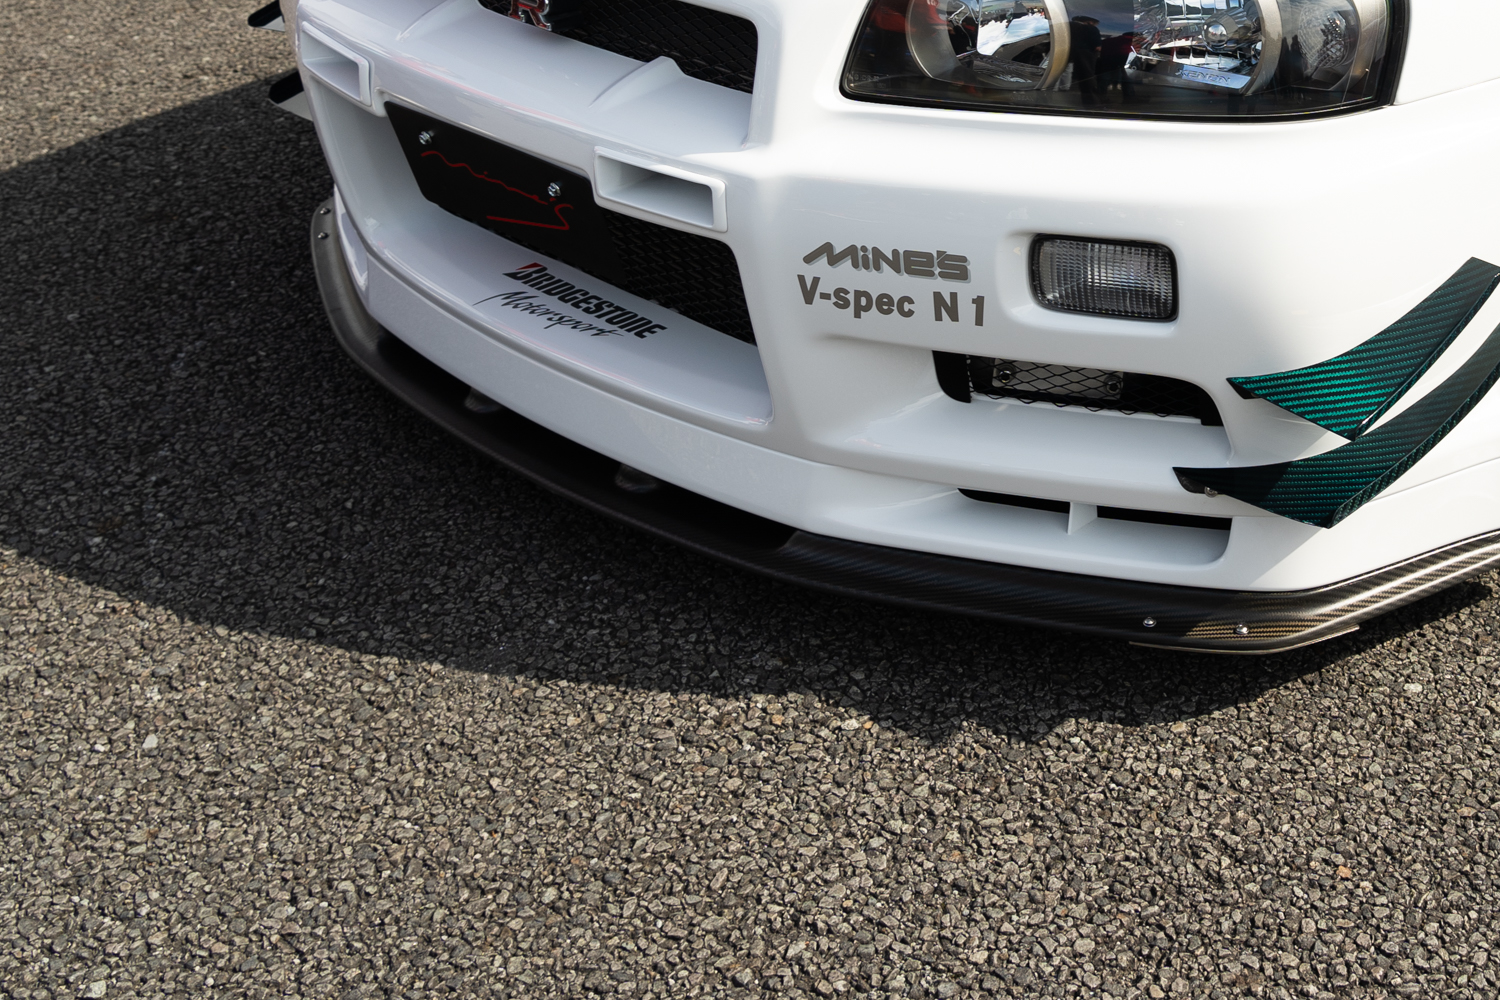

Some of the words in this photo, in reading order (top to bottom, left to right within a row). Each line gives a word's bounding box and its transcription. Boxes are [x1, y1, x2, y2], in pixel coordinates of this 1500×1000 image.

[1175, 69, 1231, 85] XENON
[472, 291, 624, 338] Motorsport
[502, 262, 668, 339] BRIDGESTONE
[797, 274, 916, 319] V-spec
